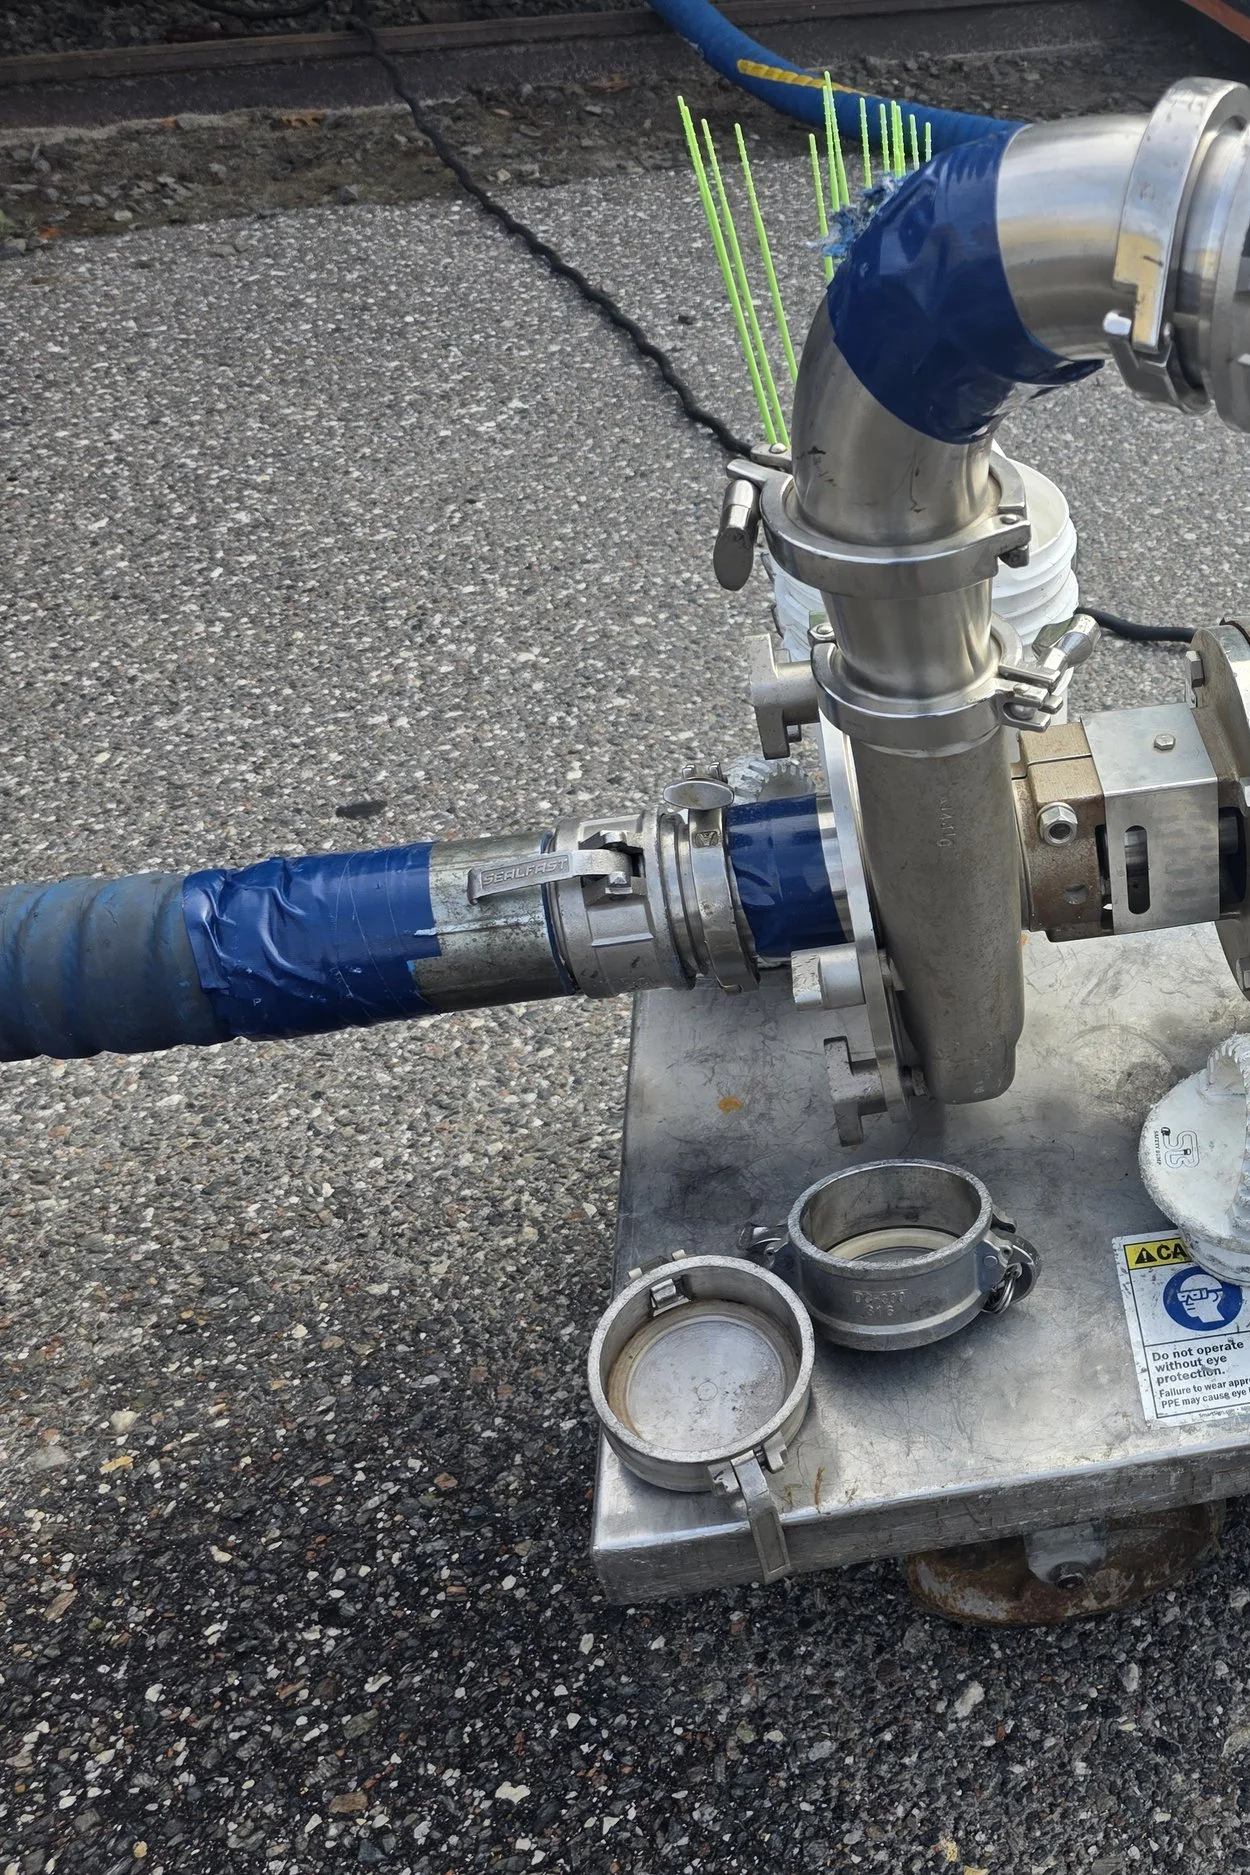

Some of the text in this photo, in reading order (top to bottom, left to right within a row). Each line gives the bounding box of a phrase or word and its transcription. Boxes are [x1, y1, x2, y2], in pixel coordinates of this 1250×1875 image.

[483, 858, 567, 885] SEALFAST
[1152, 1341, 1245, 1362] Do not operate
[1155, 1354, 1228, 1373] without eye
[1156, 1368, 1226, 1386] protection.
[1159, 1386, 1192, 1398] Failure
[1193, 1384, 1203, 1392] to
[1204, 1380, 1228, 1391] wear
[1161, 1399, 1181, 1409] PPE
[1182, 1396, 1201, 1408] may
[1203, 1391, 1231, 1403] cause
[1232, 1388, 1247, 1399] eye
